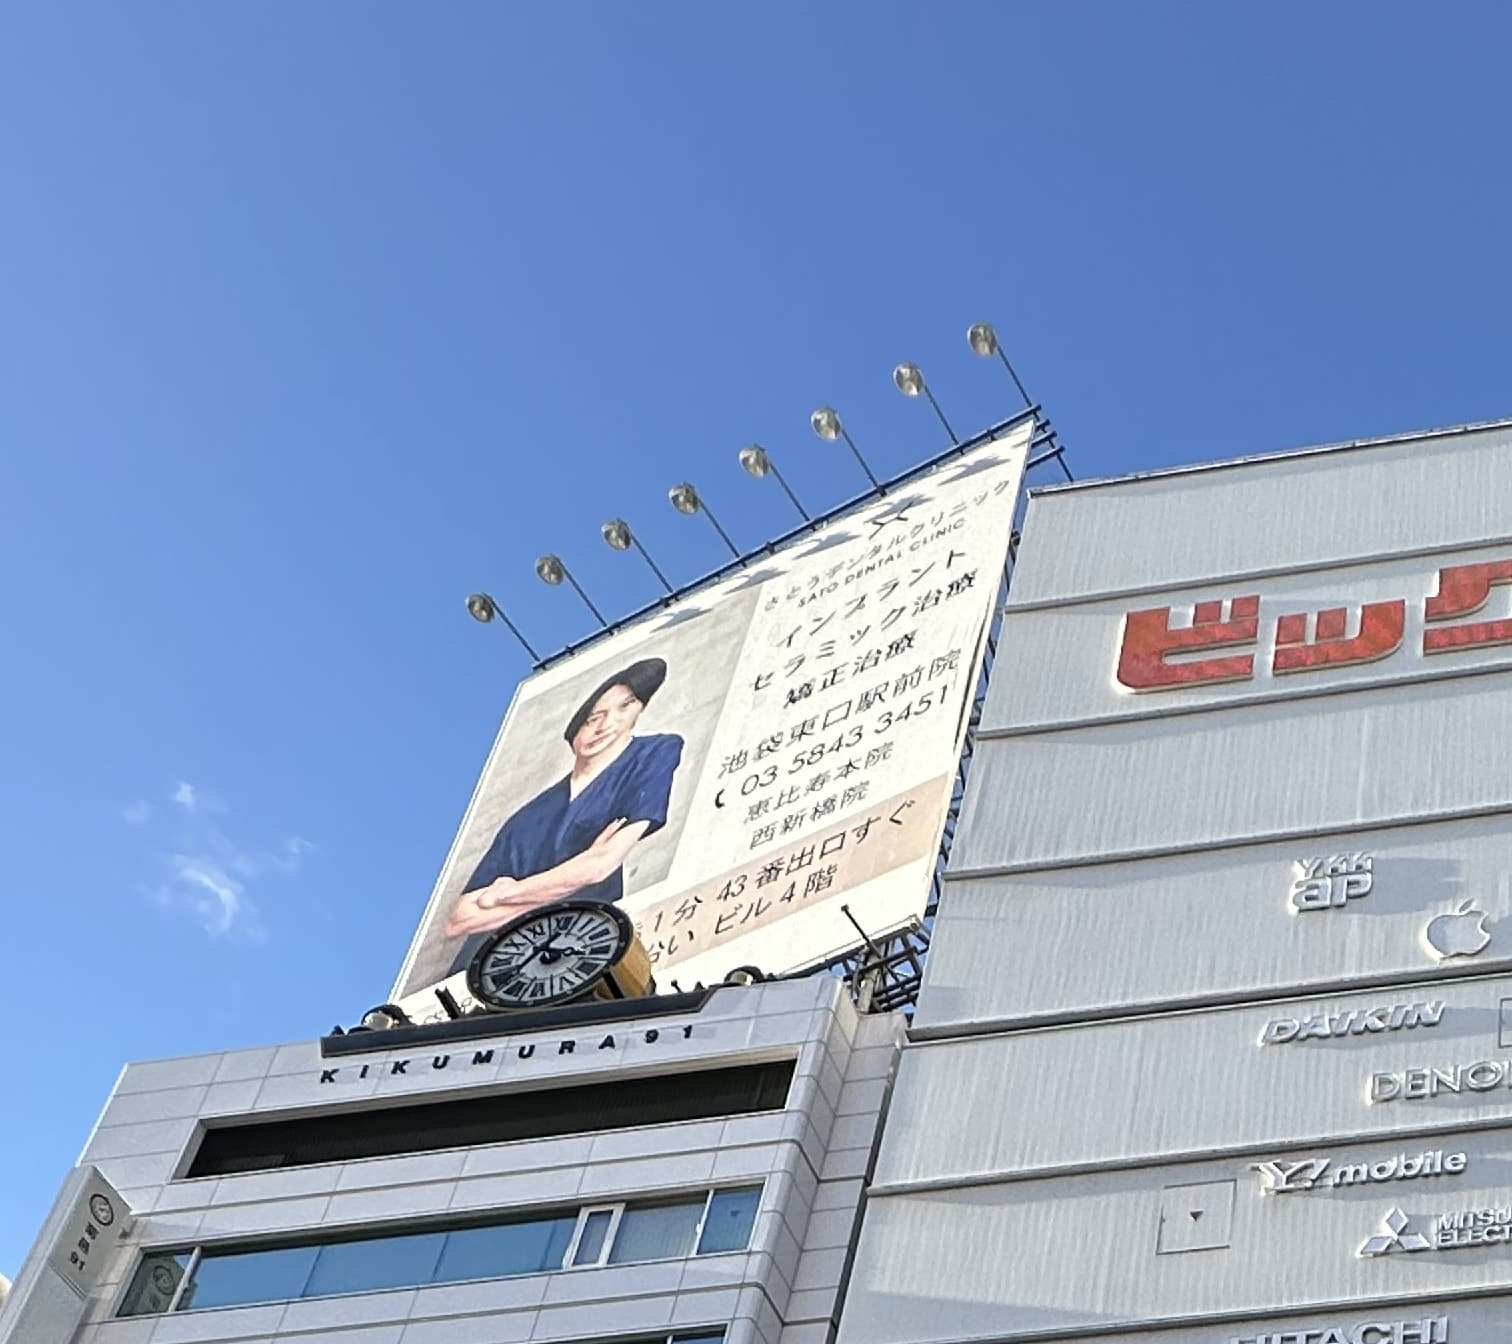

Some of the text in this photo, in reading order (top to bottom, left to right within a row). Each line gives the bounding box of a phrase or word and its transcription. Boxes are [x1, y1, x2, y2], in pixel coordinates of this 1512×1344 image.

[777, 549, 966, 647] インプラント
[797, 517, 967, 608] SATO DENTAL CLINIC
[753, 568, 978, 692] セラミック治療
[783, 629, 918, 709] 矯正治療
[717, 648, 961, 780] 池袋東口駅前院
[741, 685, 948, 797] 03 5843 3451
[1258, 1001, 1446, 1045] DAIKIN
